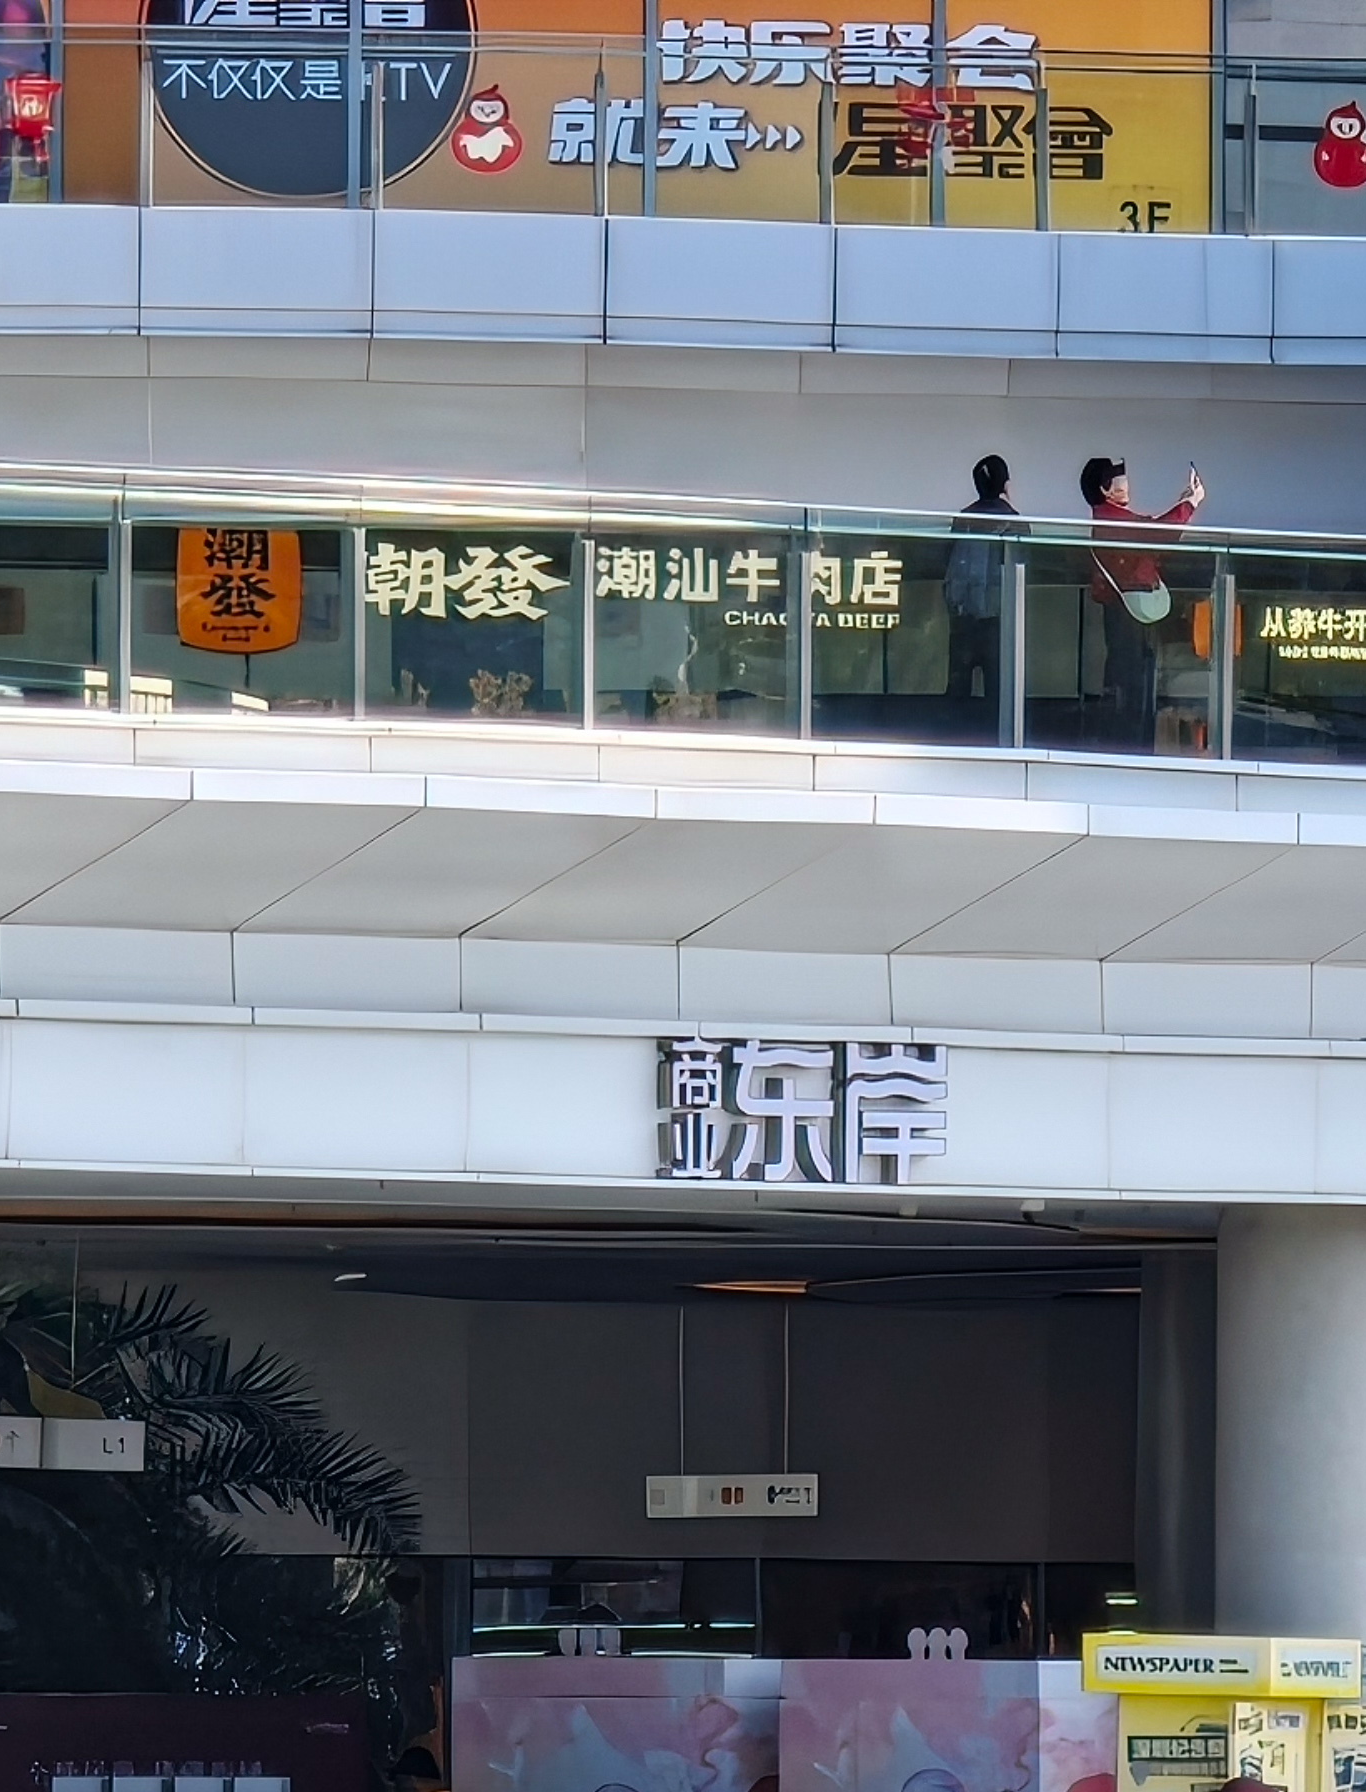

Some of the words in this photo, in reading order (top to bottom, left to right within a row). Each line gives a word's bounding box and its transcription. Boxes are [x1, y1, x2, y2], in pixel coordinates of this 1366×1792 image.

[548, 97, 748, 170] 就来
[596, 547, 903, 606] 潮汕牛肉店
[670, 1036, 723, 1179] 商业
[731, 1039, 947, 1184] 东岸
[102, 1437, 125, 1454] L1
